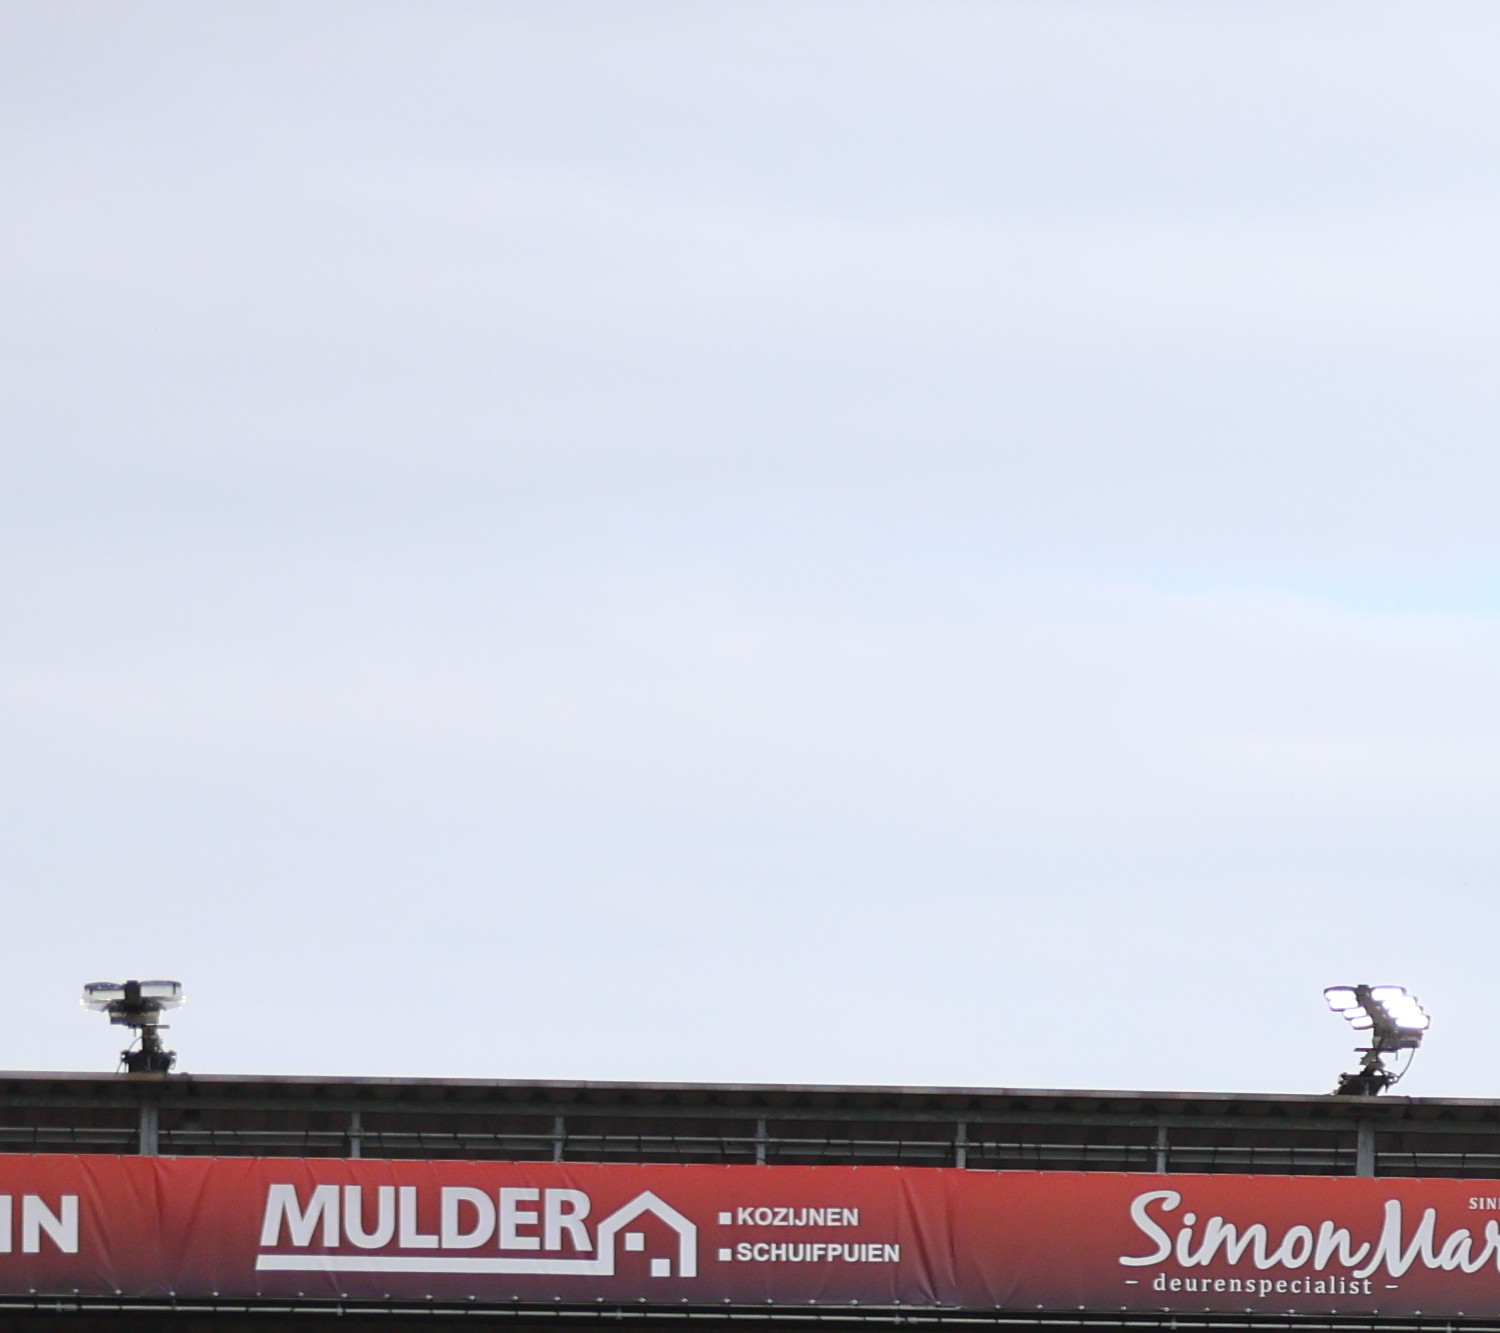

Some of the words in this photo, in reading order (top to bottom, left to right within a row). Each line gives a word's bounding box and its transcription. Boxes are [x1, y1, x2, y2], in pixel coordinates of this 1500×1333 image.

[263, 1183, 597, 1251] MULDER
[737, 1206, 859, 1227] KOZIJNEN
[1116, 1184, 1376, 1274] Simon
[736, 1242, 900, 1263] SCHUIFPUIEN
[1152, 1269, 1375, 1298] deurenspecialist
